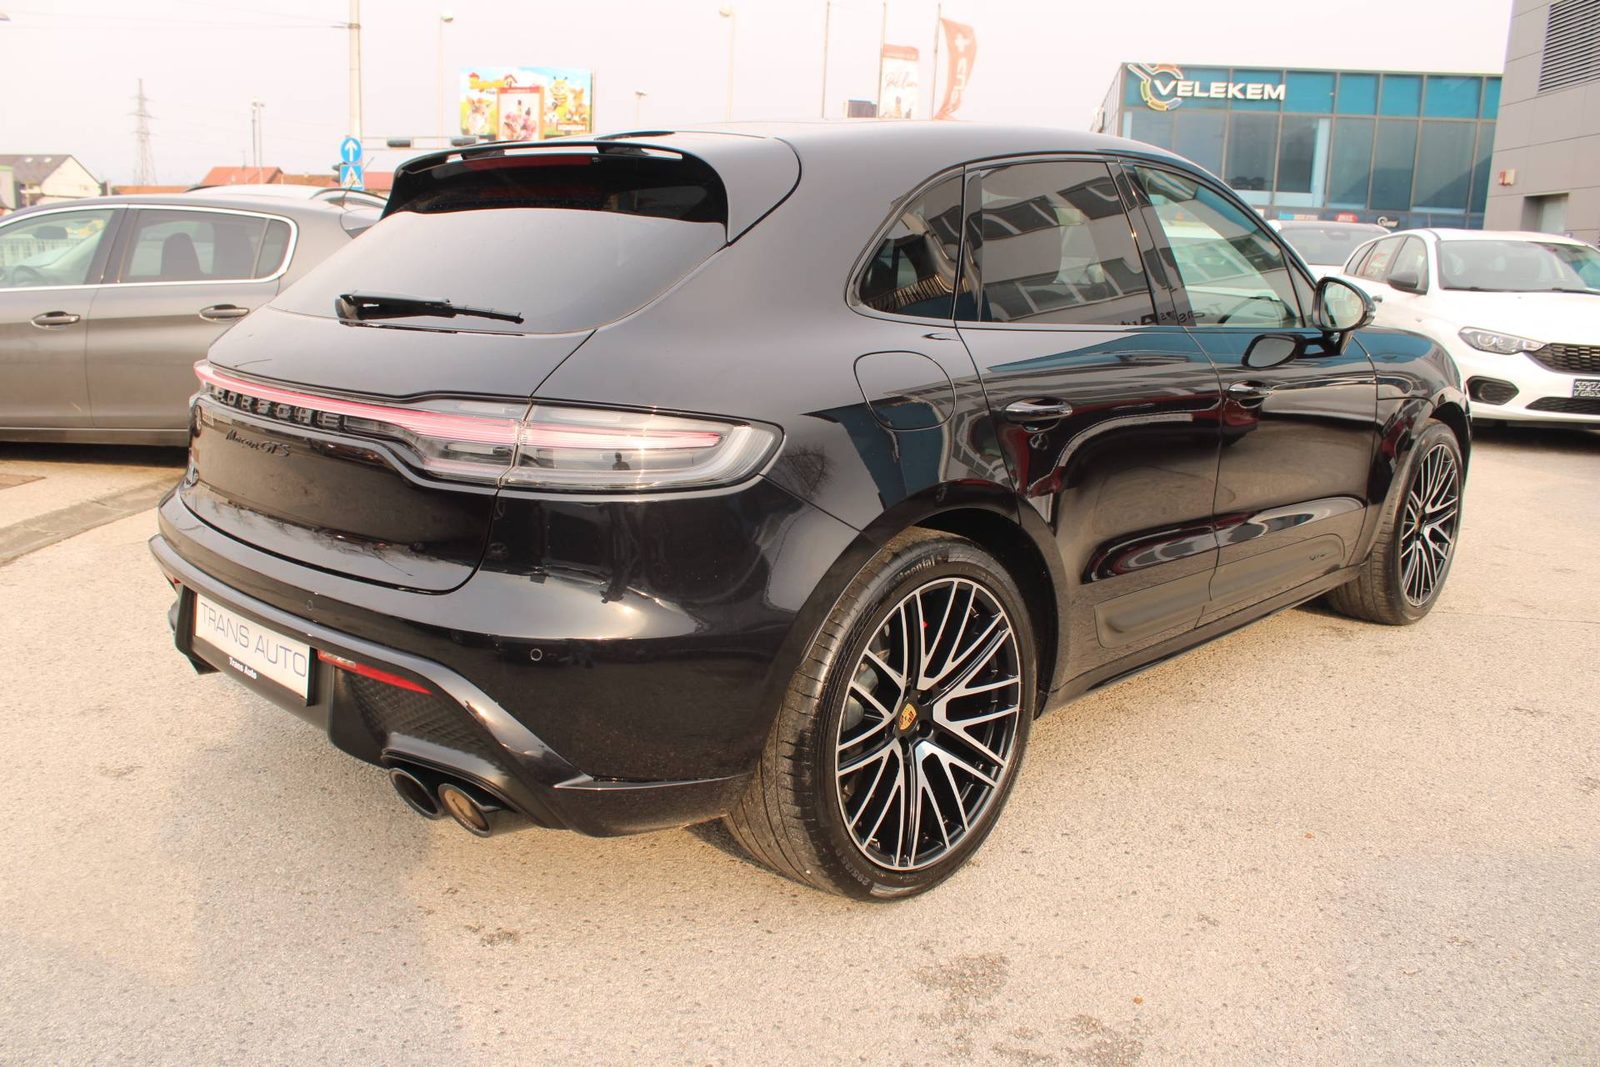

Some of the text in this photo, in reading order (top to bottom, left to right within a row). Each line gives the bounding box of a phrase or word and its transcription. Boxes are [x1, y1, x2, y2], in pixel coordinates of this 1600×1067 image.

[1154, 79, 1286, 100] VELEKEM
[214, 387, 342, 430] PORSCHE
[260, 440, 291, 457] GTS
[200, 602, 307, 678] TRANS AUTO
